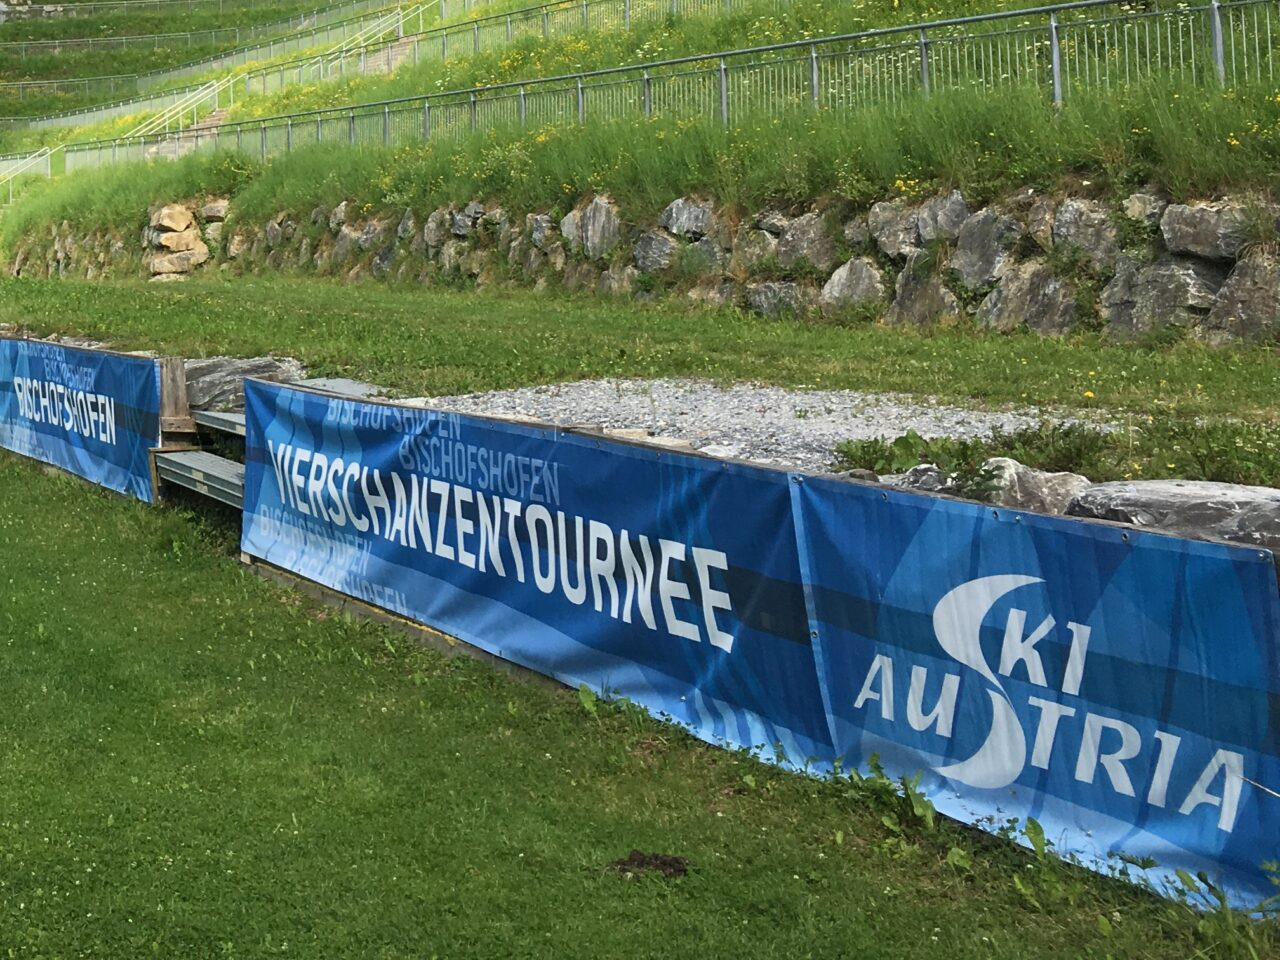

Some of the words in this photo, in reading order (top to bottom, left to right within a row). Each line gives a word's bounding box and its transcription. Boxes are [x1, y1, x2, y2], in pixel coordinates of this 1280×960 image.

[14, 376, 117, 446] BISCHOFSHOFEN
[326, 397, 461, 441] BISCHOFSHOFEN
[398, 434, 561, 506] BISCHOFSHOFEN
[266, 439, 735, 654] VIERSCHANZENTOURNEE
[931, 573, 1093, 789] SKI
